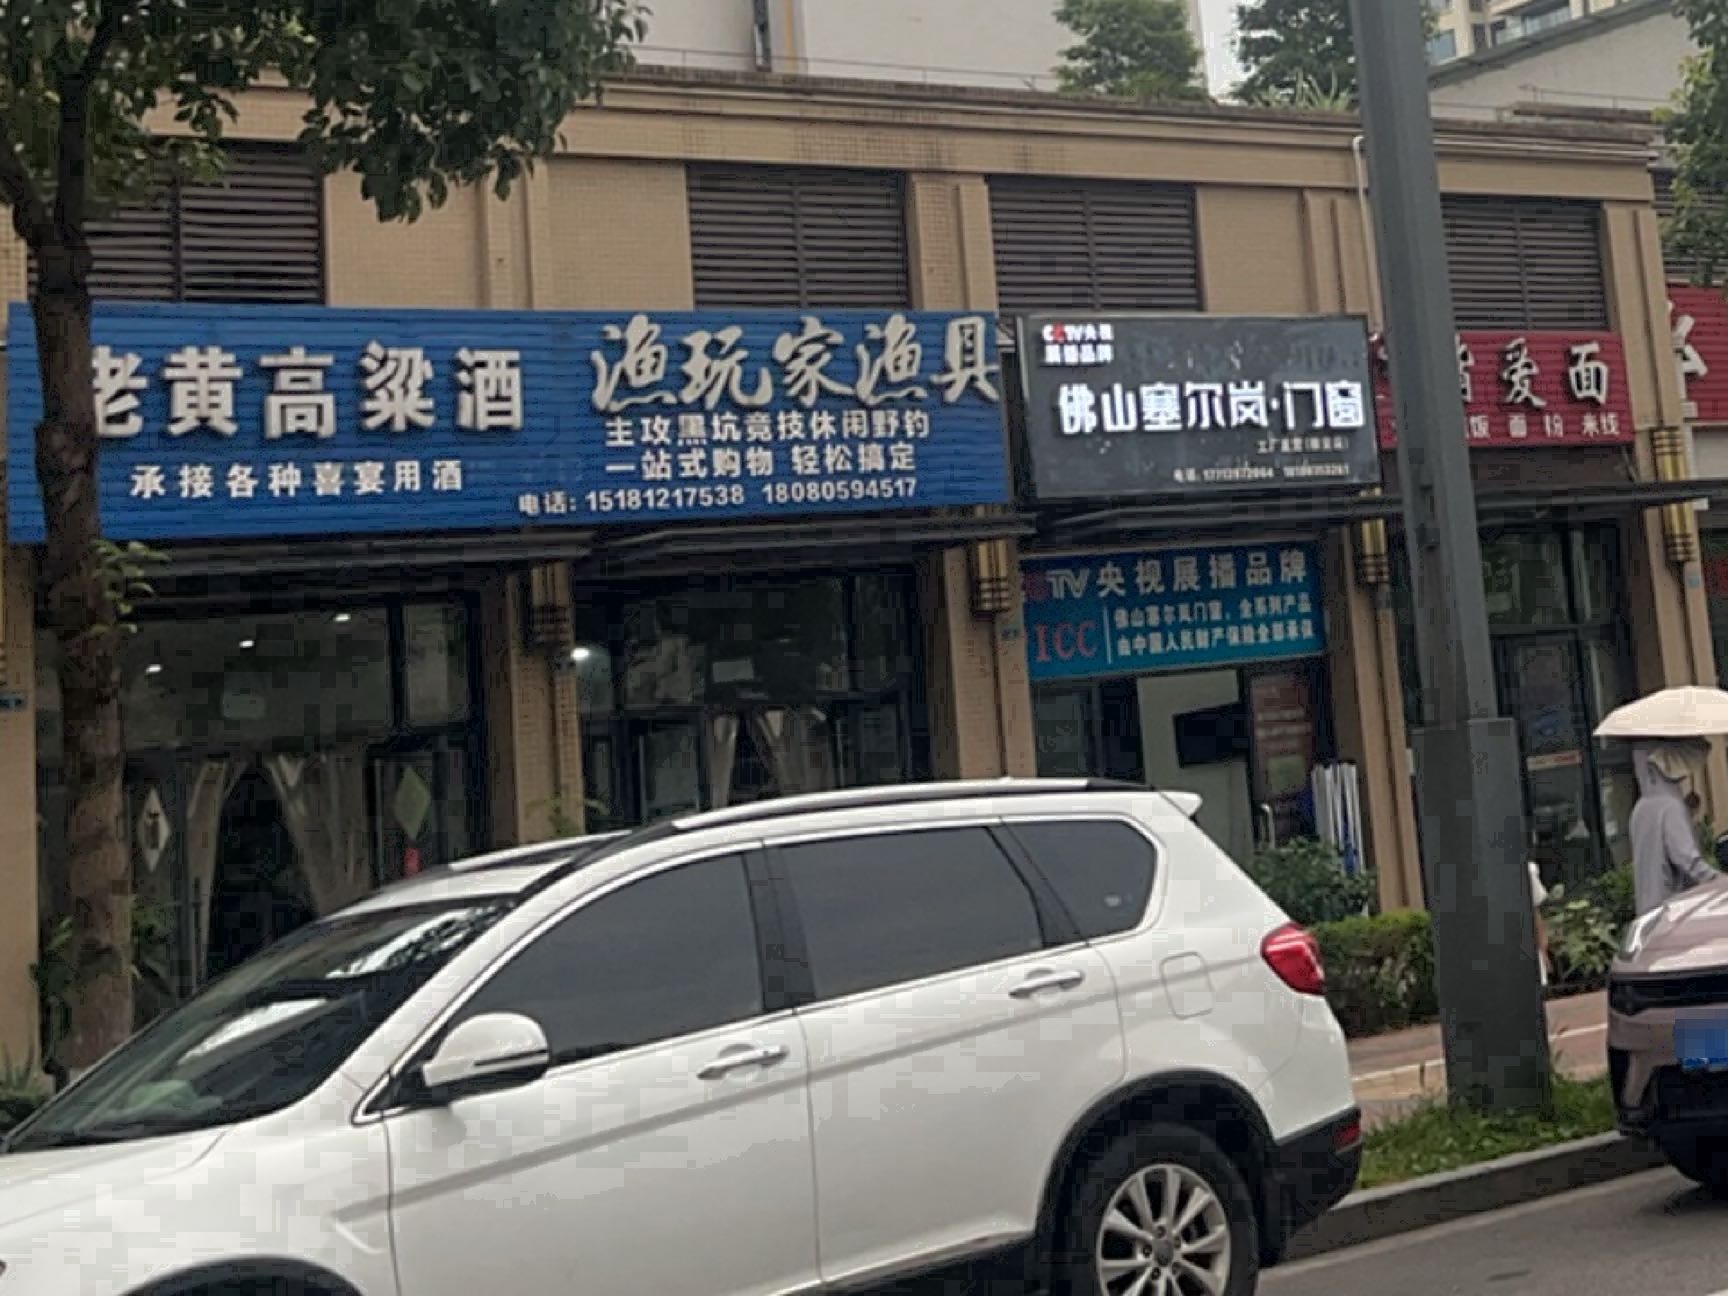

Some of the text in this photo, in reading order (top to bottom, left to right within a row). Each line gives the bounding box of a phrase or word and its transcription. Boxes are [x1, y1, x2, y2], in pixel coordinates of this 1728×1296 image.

[591, 315, 999, 412] 渔玩家渔具
[606, 410, 930, 448] 主攻黑坑竞技休闲野钓
[131, 460, 463, 498] 承接各种喜宴用酒
[606, 442, 916, 481] 一站式购物 轻松搞定
